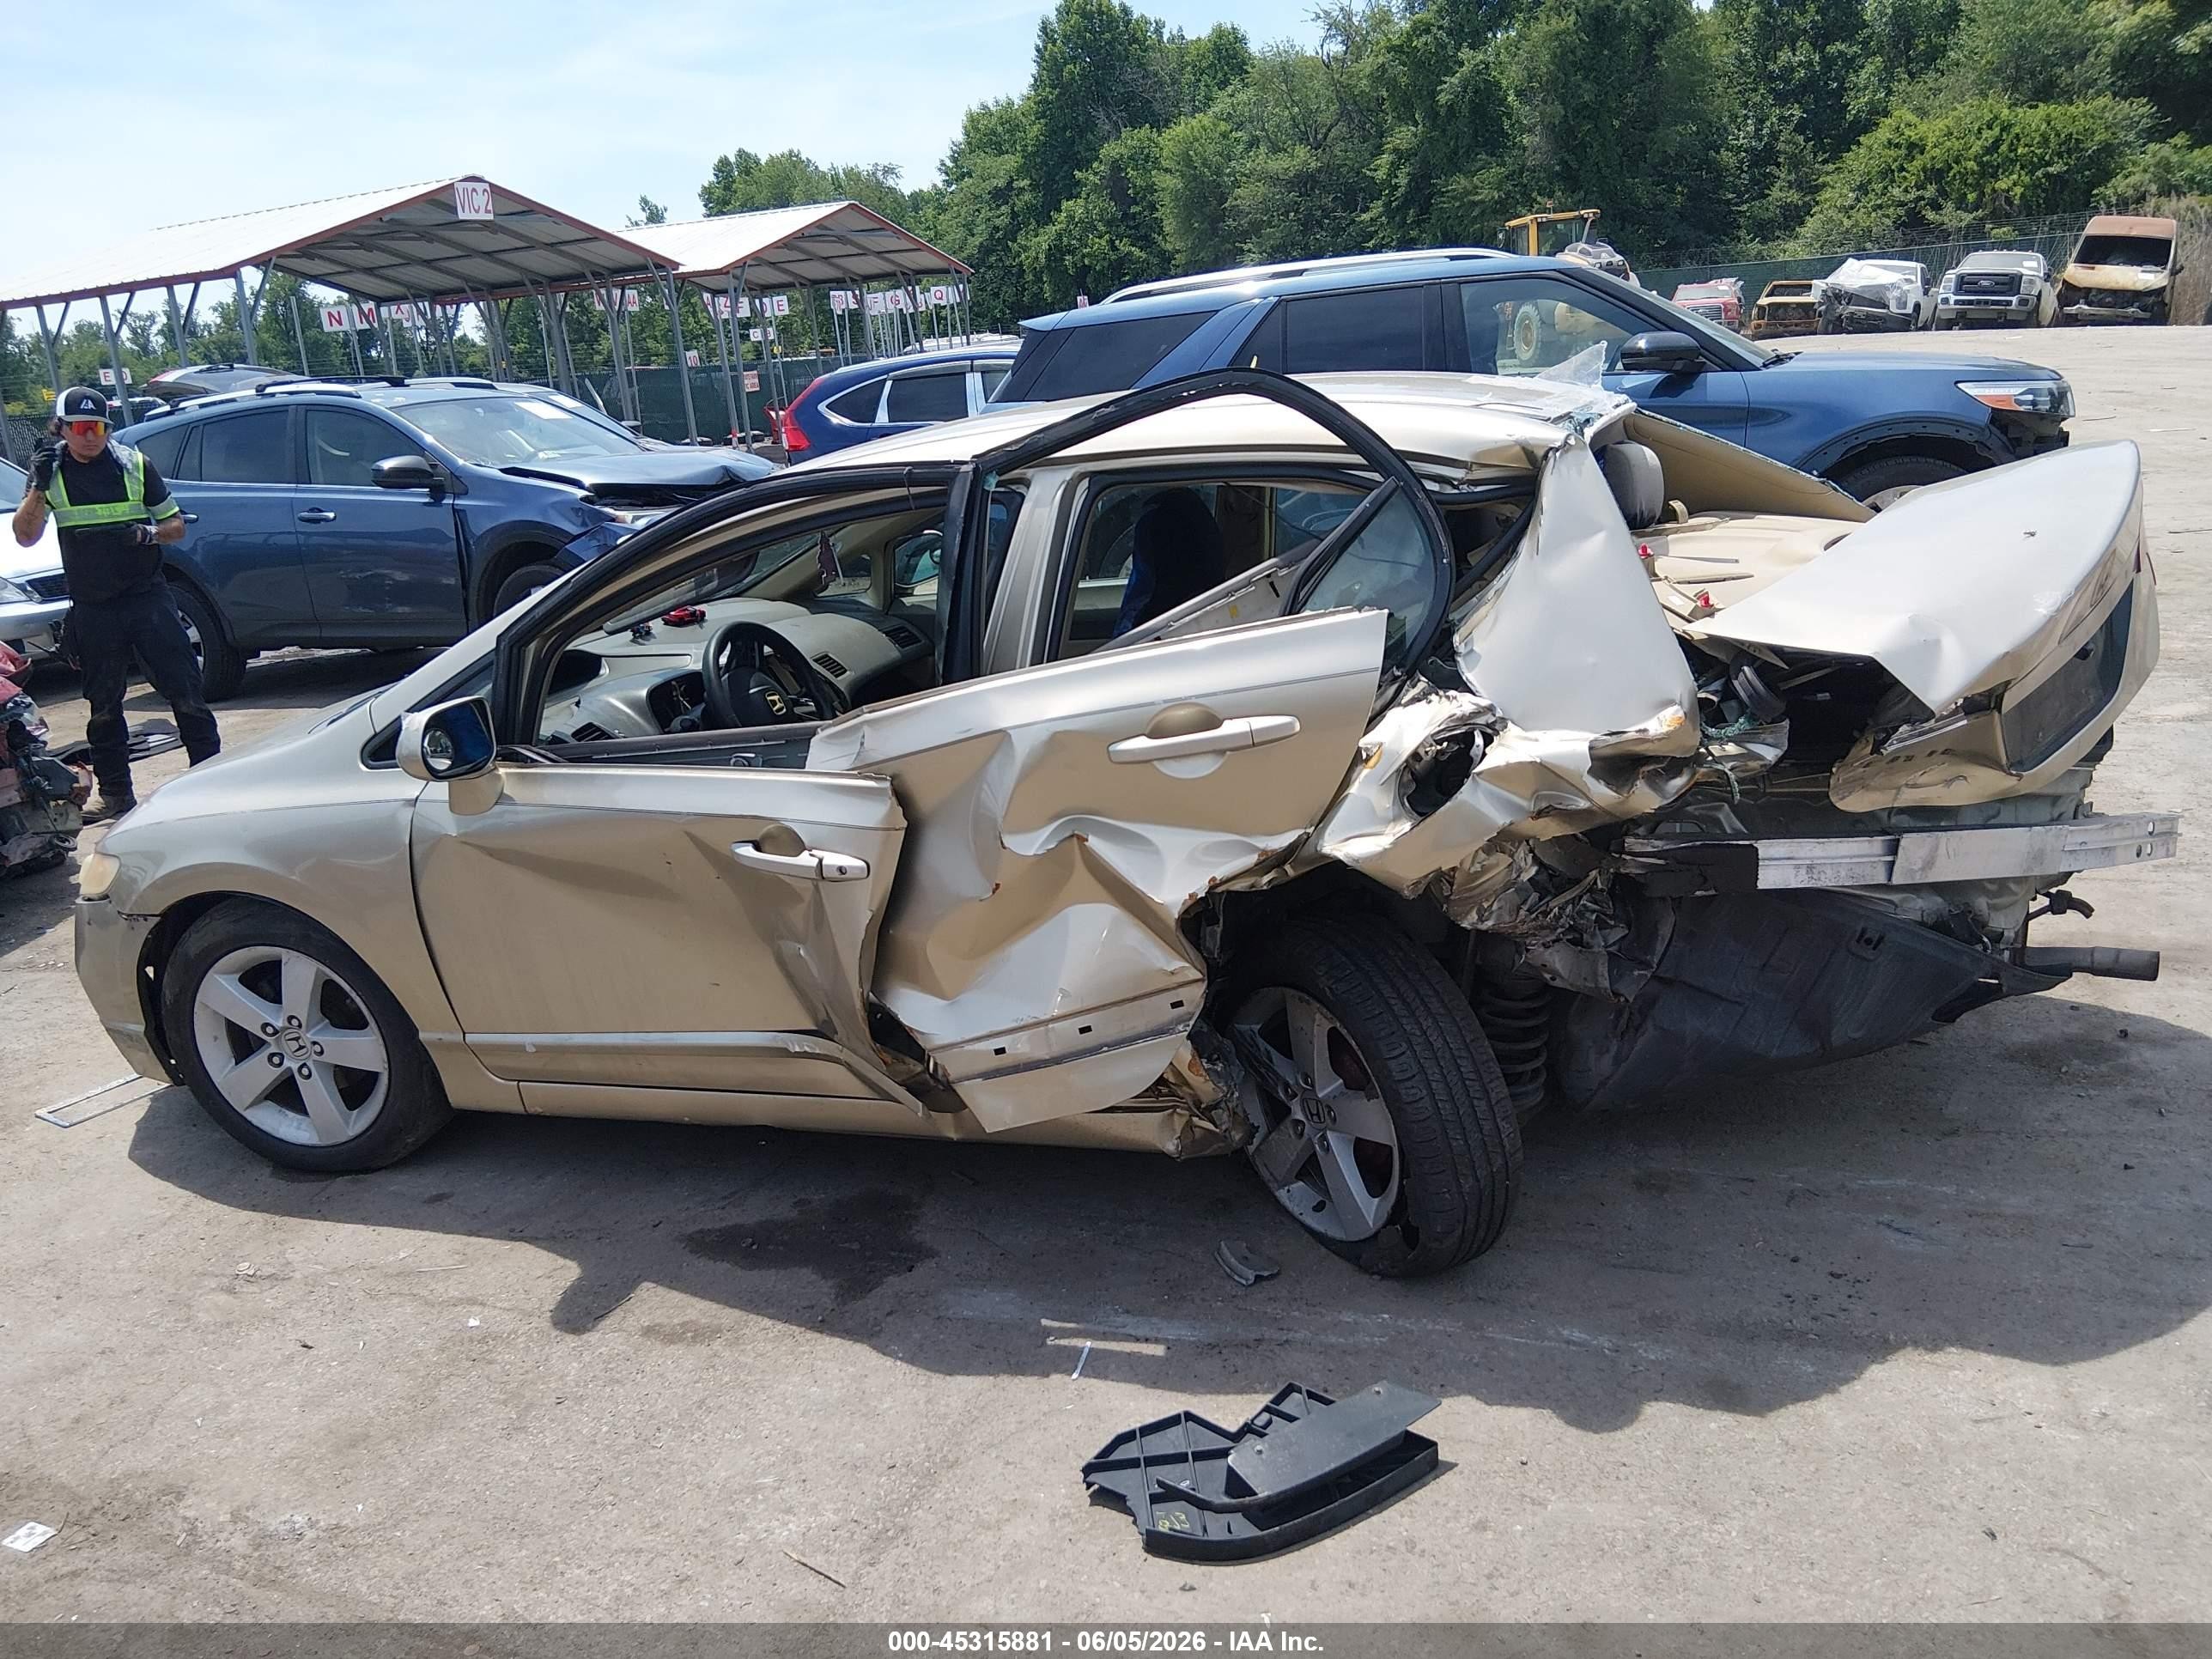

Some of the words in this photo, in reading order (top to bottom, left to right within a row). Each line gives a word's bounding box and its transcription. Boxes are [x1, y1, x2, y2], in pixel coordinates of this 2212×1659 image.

[456, 187, 480, 214] VIC
[483, 187, 493, 214] 2
[627, 293, 637, 307] AA
[890, 295, 901, 306] G
[933, 289, 944, 301] Q
[776, 299, 786, 312] E
[327, 310, 343, 327] N
[357, 307, 377, 325] M
[752, 331, 759, 339] C
[689, 356, 698, 367] 10
[103, 371, 112, 382] E
